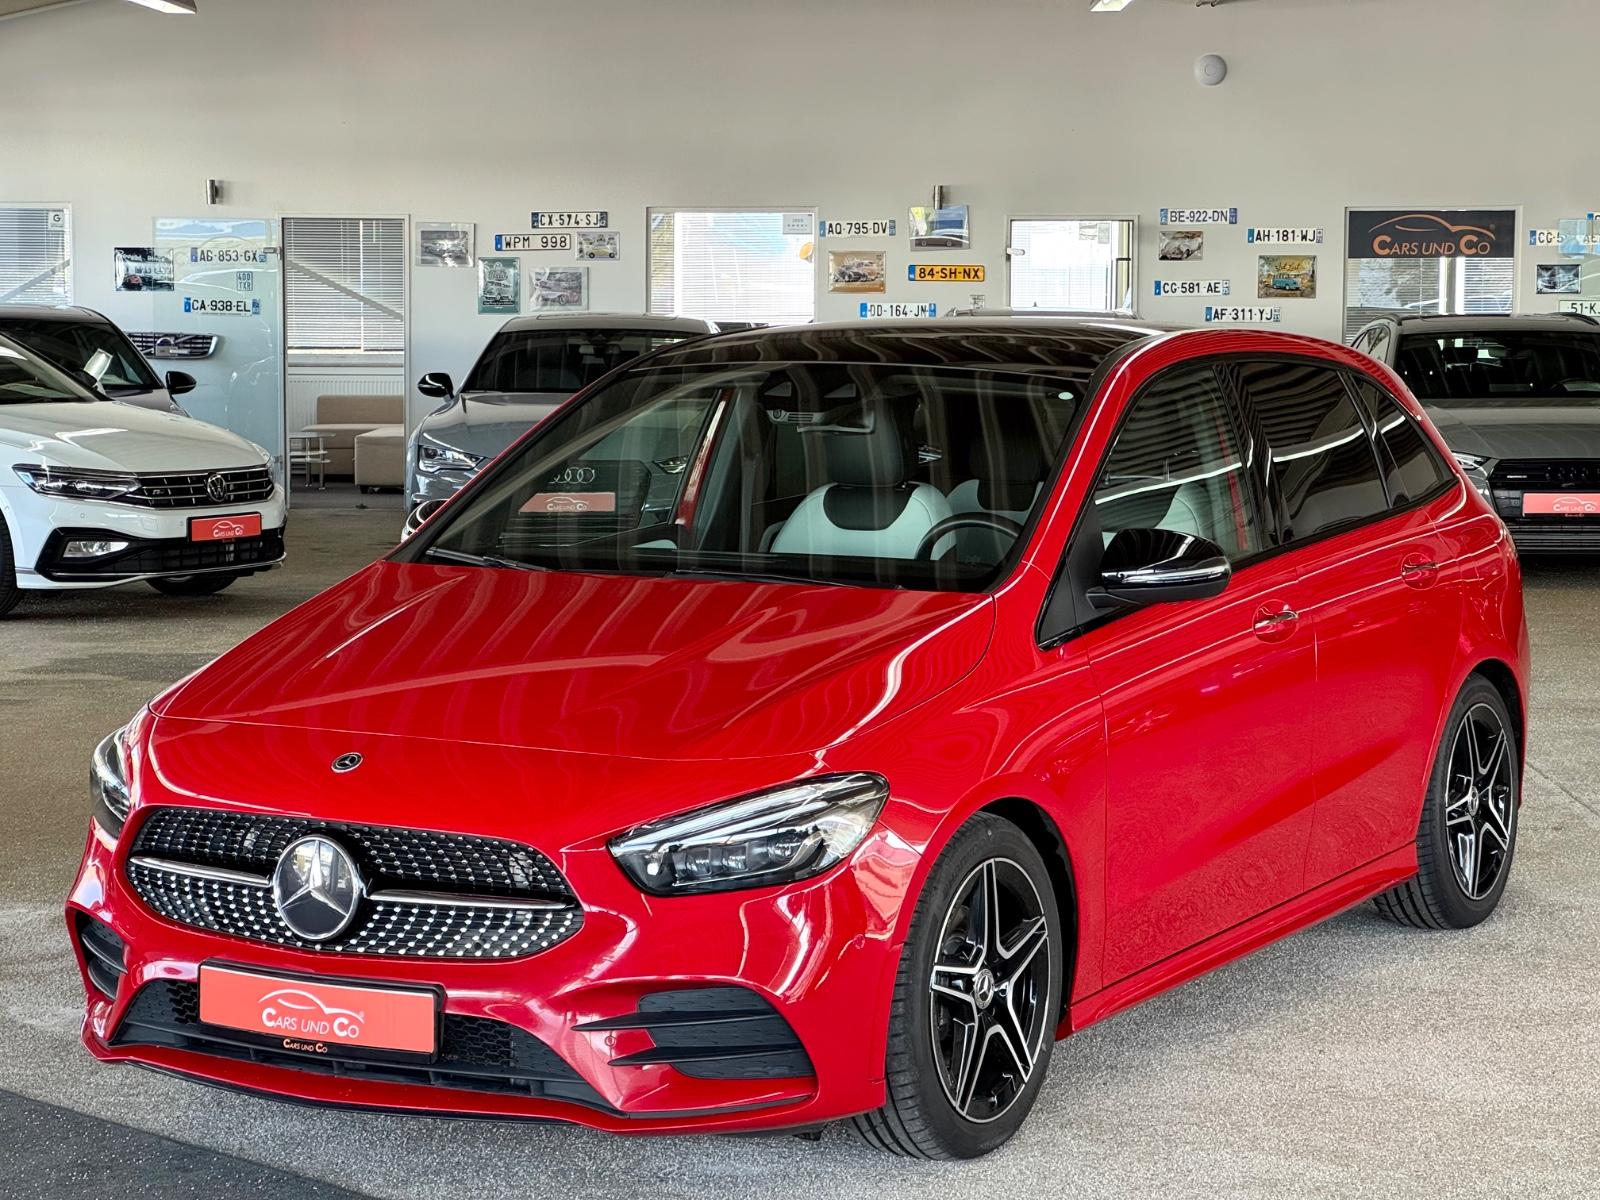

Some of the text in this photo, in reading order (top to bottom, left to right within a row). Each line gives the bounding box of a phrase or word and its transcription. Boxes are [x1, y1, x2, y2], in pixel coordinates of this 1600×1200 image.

[1169, 211, 1228, 222] BE-922-DN
[827, 222, 888, 235] AQ-795-DV
[504, 235, 567, 249] WPM 998
[1255, 229, 1315, 242] AH-181-WJ
[1421, 242, 1456, 255] UND
[918, 267, 980, 279] 84-SH-NX
[192, 300, 251, 312] CA-938-EL
[1212, 308, 1273, 320] AF-311-YJ
[301, 1020, 330, 1035] UND
